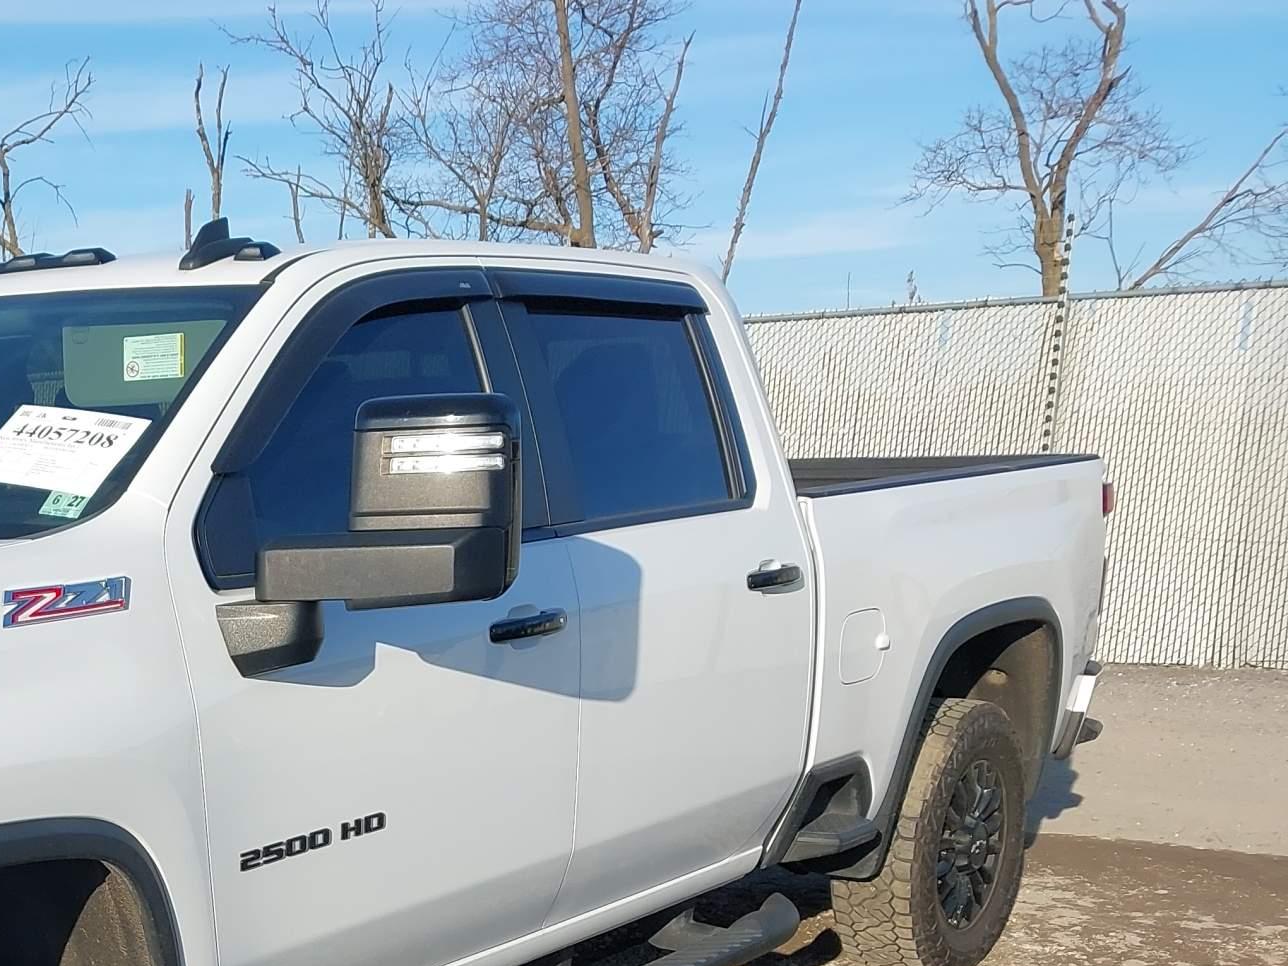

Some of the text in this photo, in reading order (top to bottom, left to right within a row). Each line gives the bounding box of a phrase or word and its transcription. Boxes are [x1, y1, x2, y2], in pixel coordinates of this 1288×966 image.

[12, 422, 119, 449] 44057208
[52, 494, 86, 507] 6 27
[2, 575, 132, 628] Z71
[239, 811, 387, 873] 2500 HD
